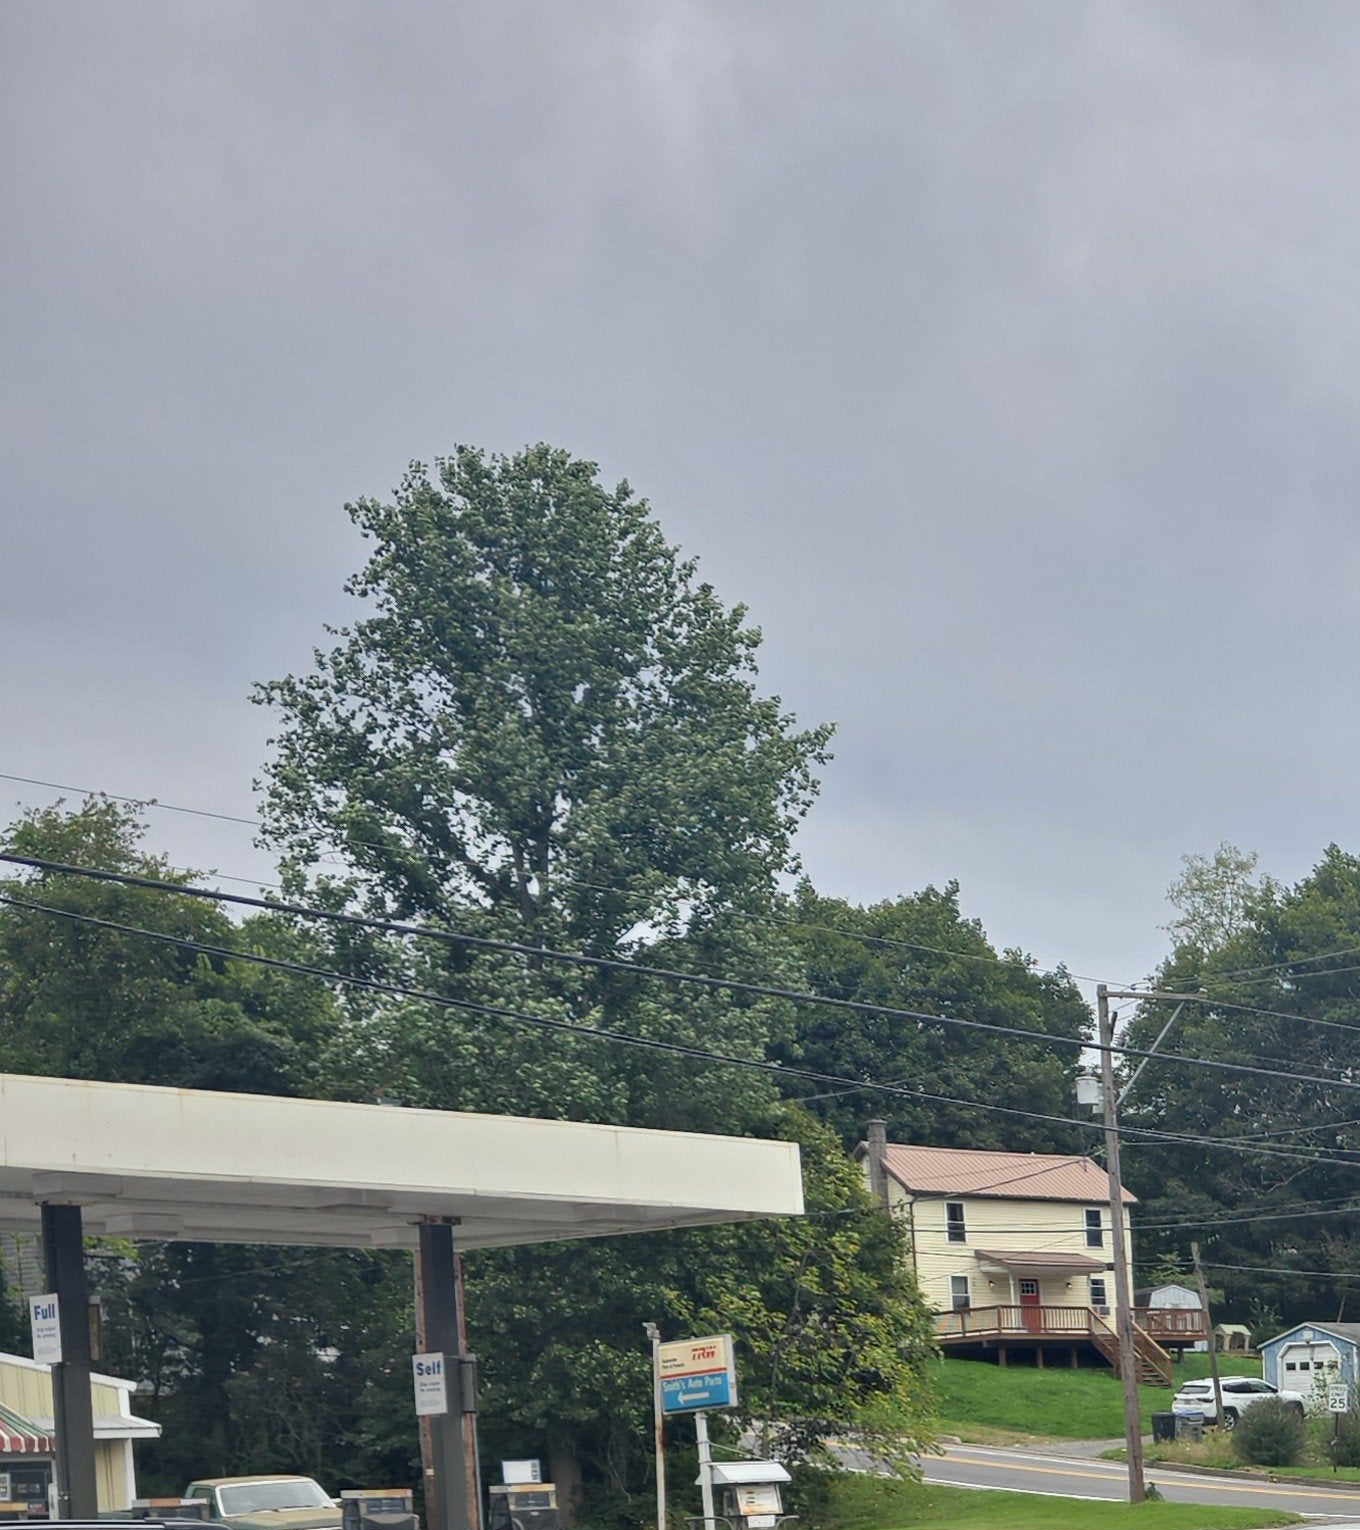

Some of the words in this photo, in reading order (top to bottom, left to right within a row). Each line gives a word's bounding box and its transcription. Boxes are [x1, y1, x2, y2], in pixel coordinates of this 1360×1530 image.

[34, 1304, 55, 1320] Full
[416, 1361, 441, 1376] Self
[1331, 1398, 1346, 1408] 25
